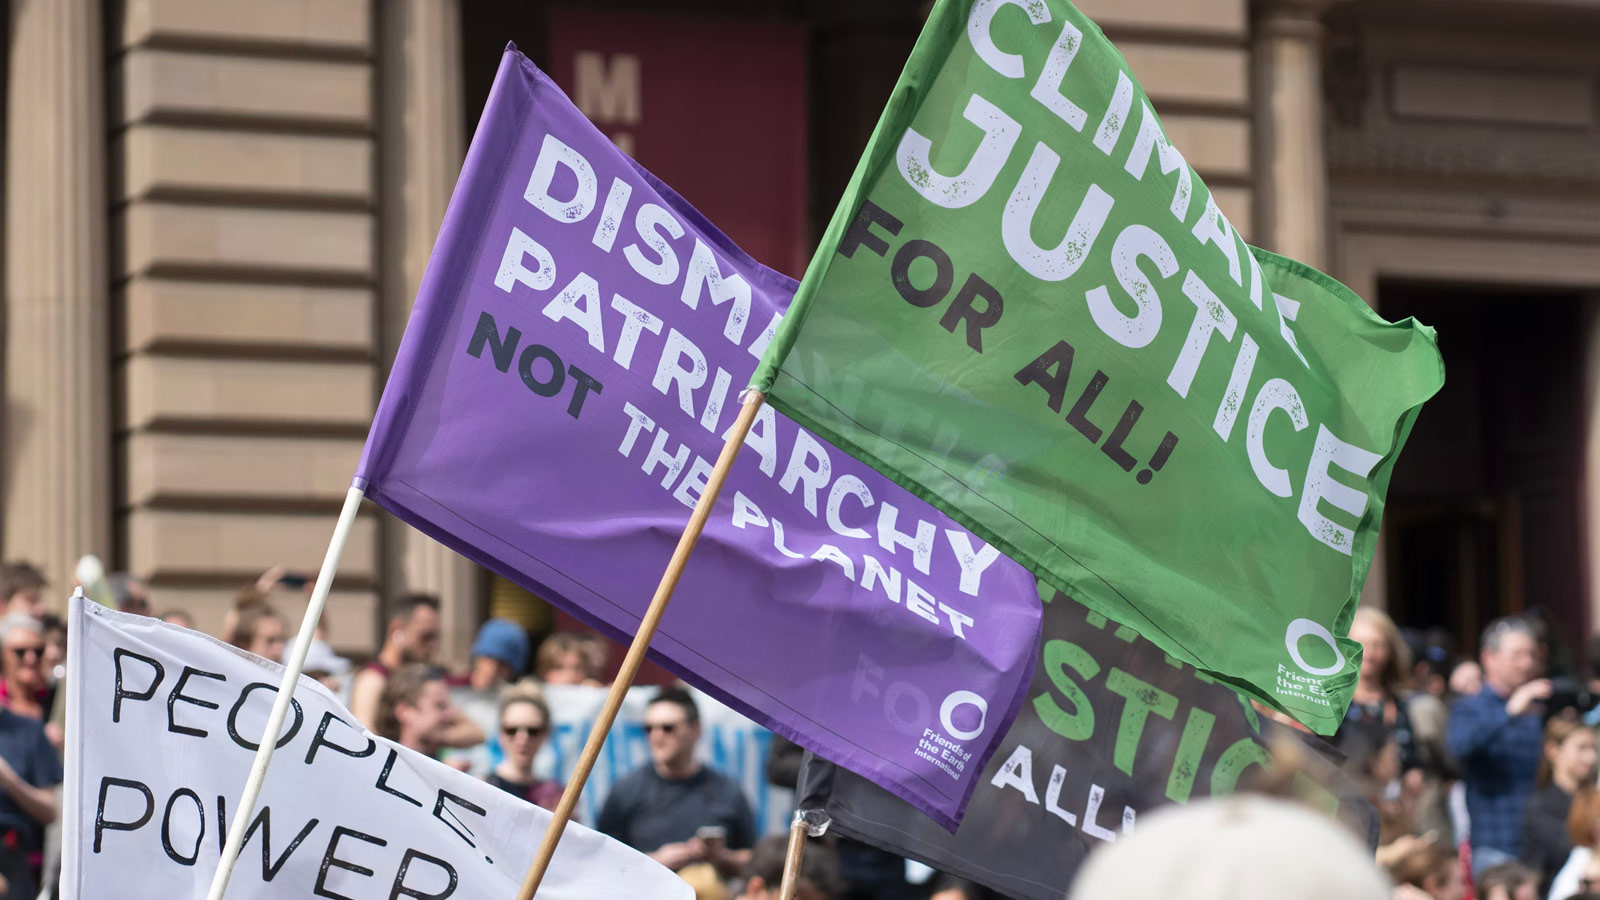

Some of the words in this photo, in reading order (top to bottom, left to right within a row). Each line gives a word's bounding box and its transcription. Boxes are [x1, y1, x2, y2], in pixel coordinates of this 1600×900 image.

[837, 200, 1004, 354] FOR
[1014, 340, 1180, 485] ALL!
[896, 93, 1385, 556] JUSTICE
[494, 226, 1001, 597] PATRIARCHY
[466, 311, 603, 420] NOT
[618, 401, 716, 511] THE
[732, 490, 974, 640] PLANET
[922, 727, 965, 757] Friends
[963, 752, 972, 762] of
[1276, 675, 1303, 691] the
[914, 747, 960, 781] International
[918, 738, 939, 754] the
[941, 749, 965, 773] Earth
[94, 776, 459, 900] POWER
